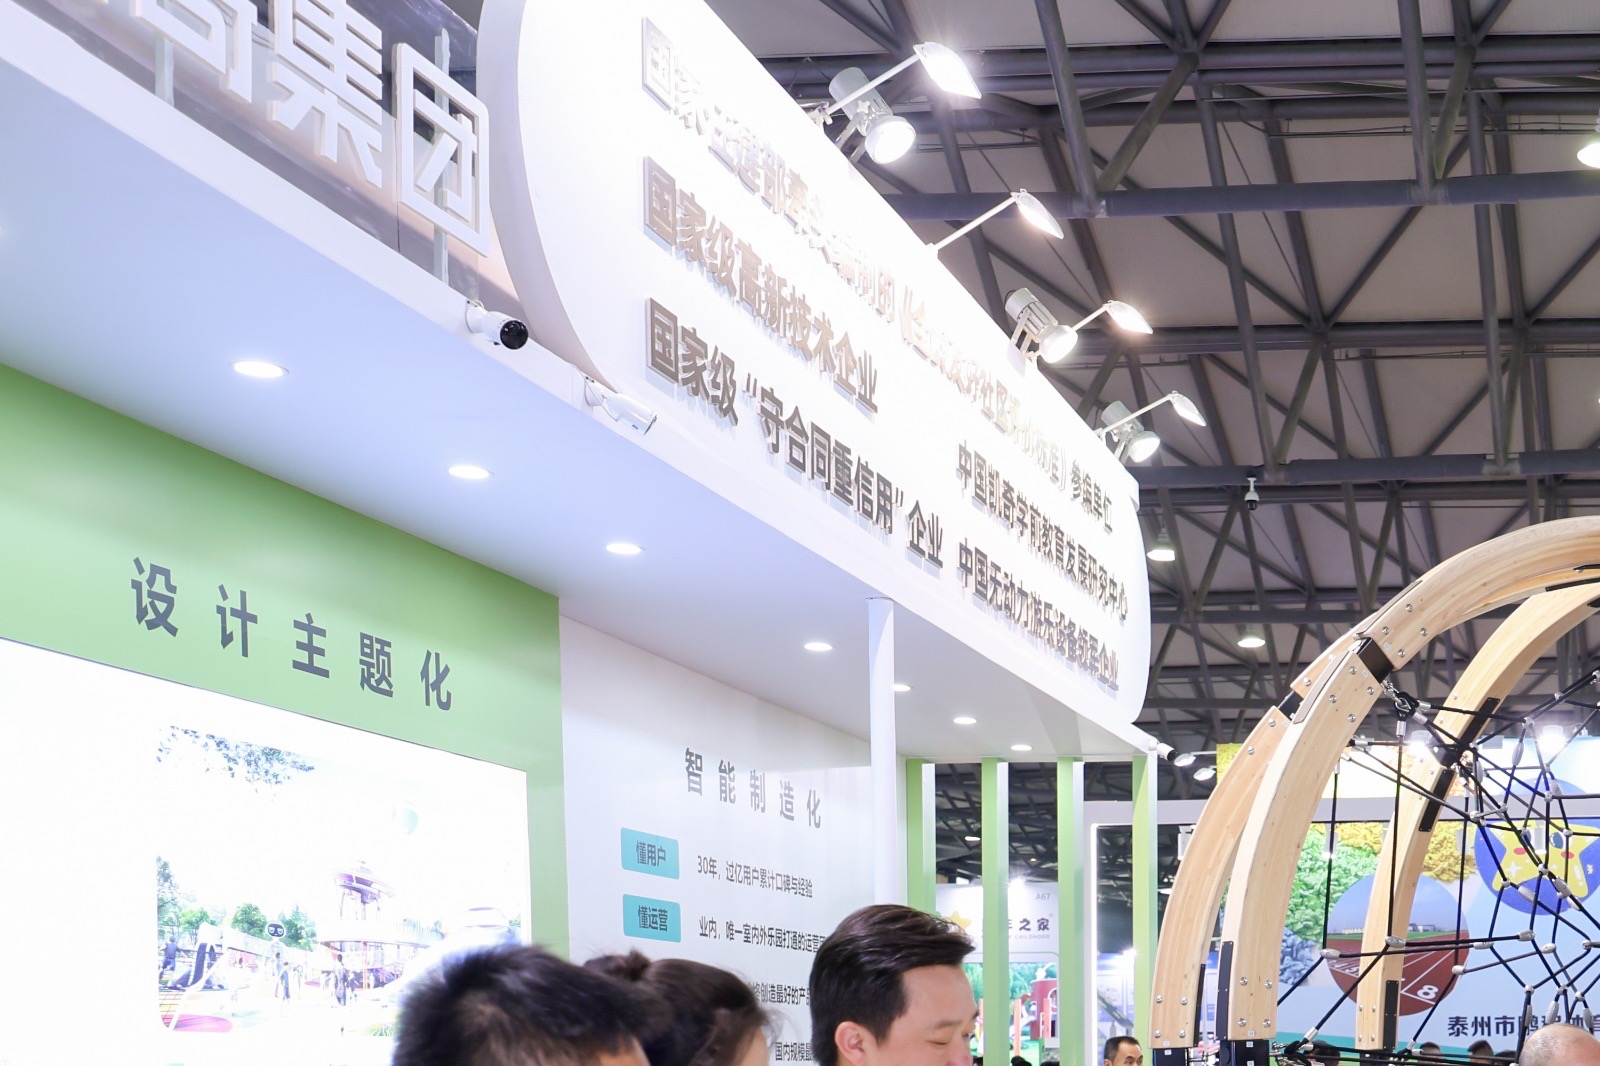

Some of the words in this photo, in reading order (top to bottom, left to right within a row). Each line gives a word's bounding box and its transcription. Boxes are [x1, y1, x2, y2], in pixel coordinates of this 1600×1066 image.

[643, 154, 878, 414] 国家级高新技术企业
[131, 557, 453, 711] 设计主题化
[685, 747, 822, 829] 智能制造化
[635, 840, 667, 867] 懂用户
[637, 905, 668, 932] 懂运营
